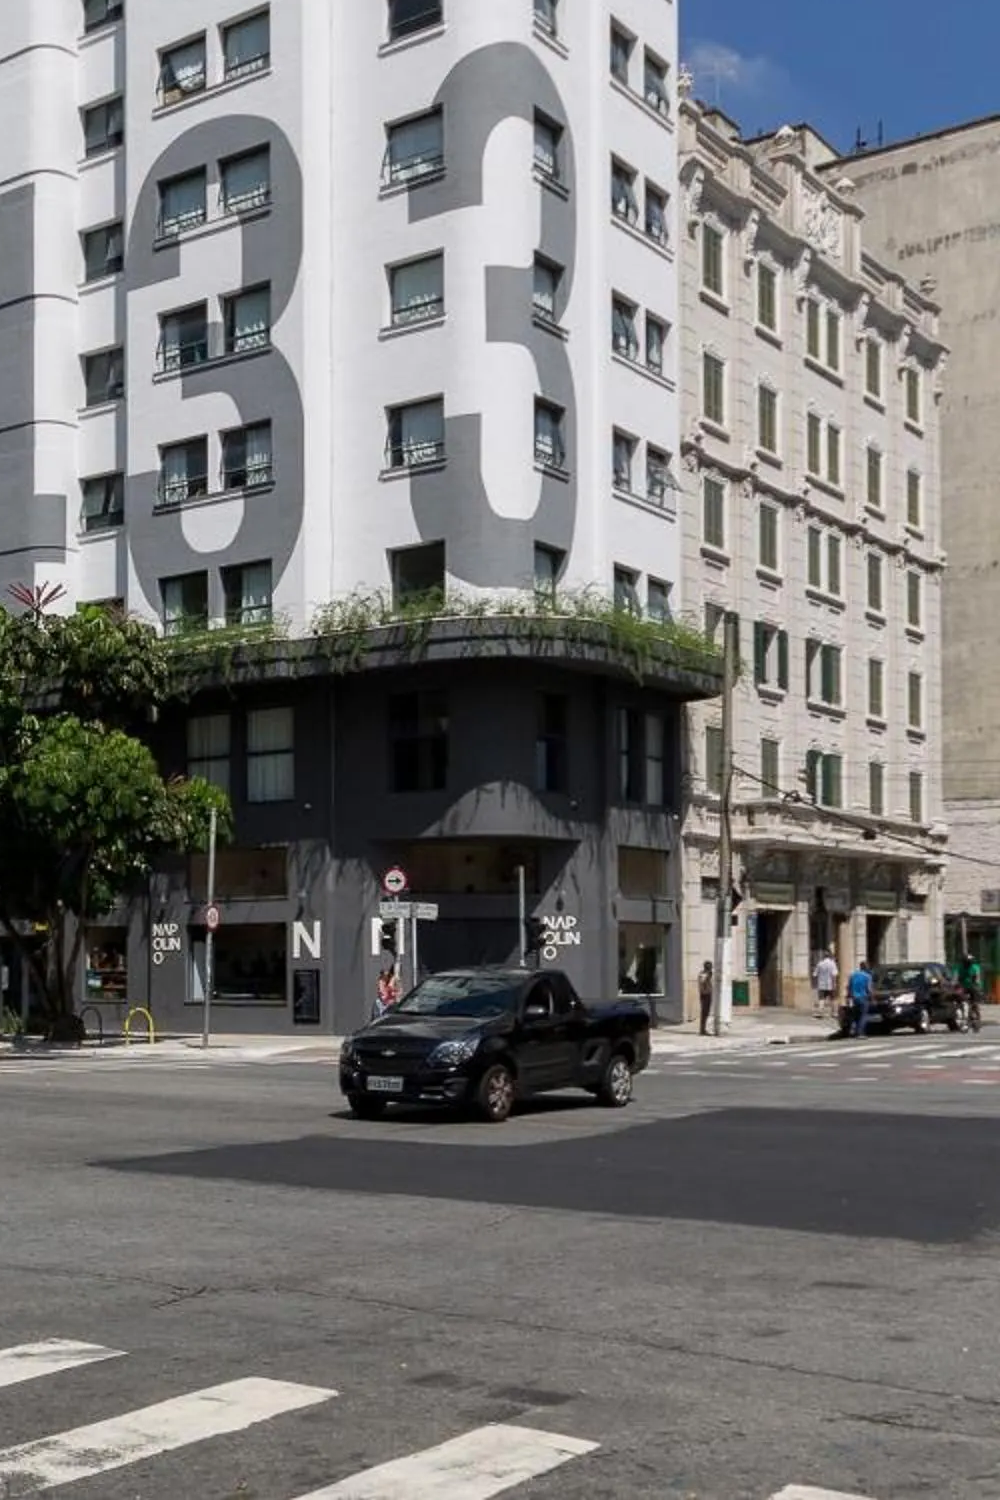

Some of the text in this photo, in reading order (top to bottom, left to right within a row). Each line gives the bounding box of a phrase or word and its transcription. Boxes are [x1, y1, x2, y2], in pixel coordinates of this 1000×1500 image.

[543, 915, 577, 930] NAP
[152, 923, 179, 937] NAP
[293, 920, 321, 958] N
[153, 951, 164, 965] O
[543, 946, 557, 960] O
